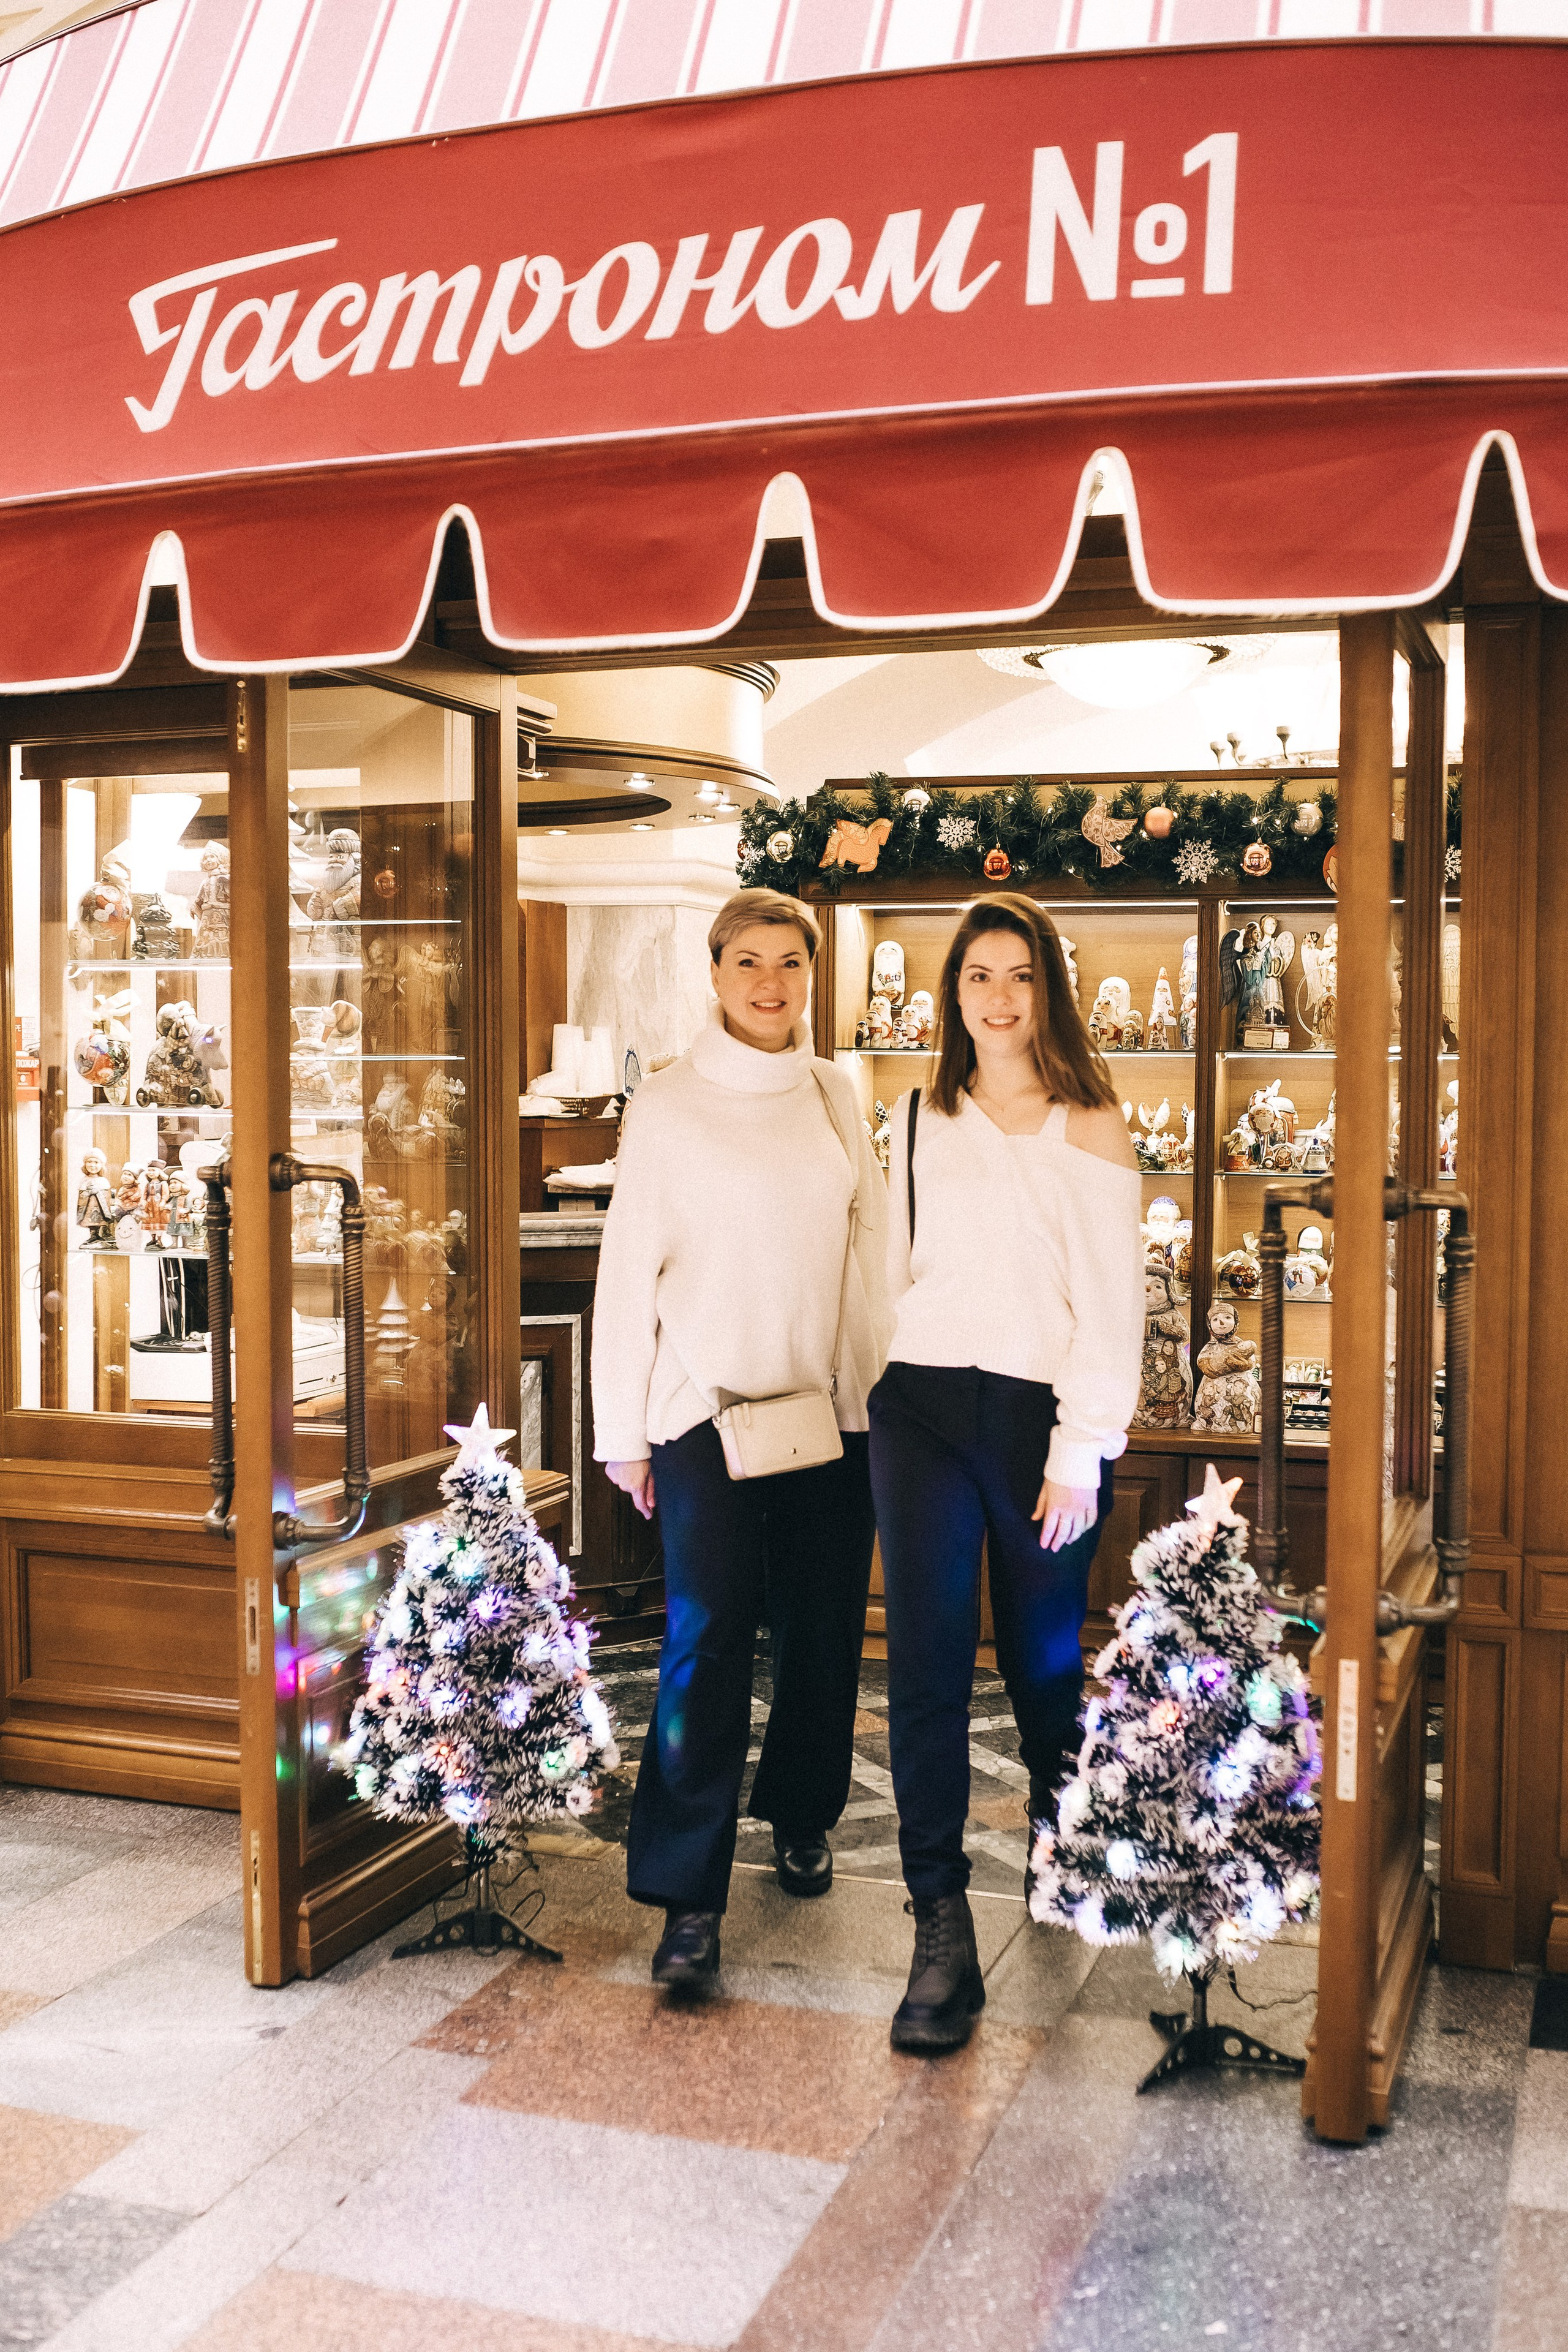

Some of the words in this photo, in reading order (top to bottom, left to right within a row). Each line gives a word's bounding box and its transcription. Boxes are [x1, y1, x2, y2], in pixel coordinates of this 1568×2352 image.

[124, 203, 1001, 434] Гастроном
[1025, 132, 1238, 307] №1
[15, 1059, 40, 1068] ПОЖАР
